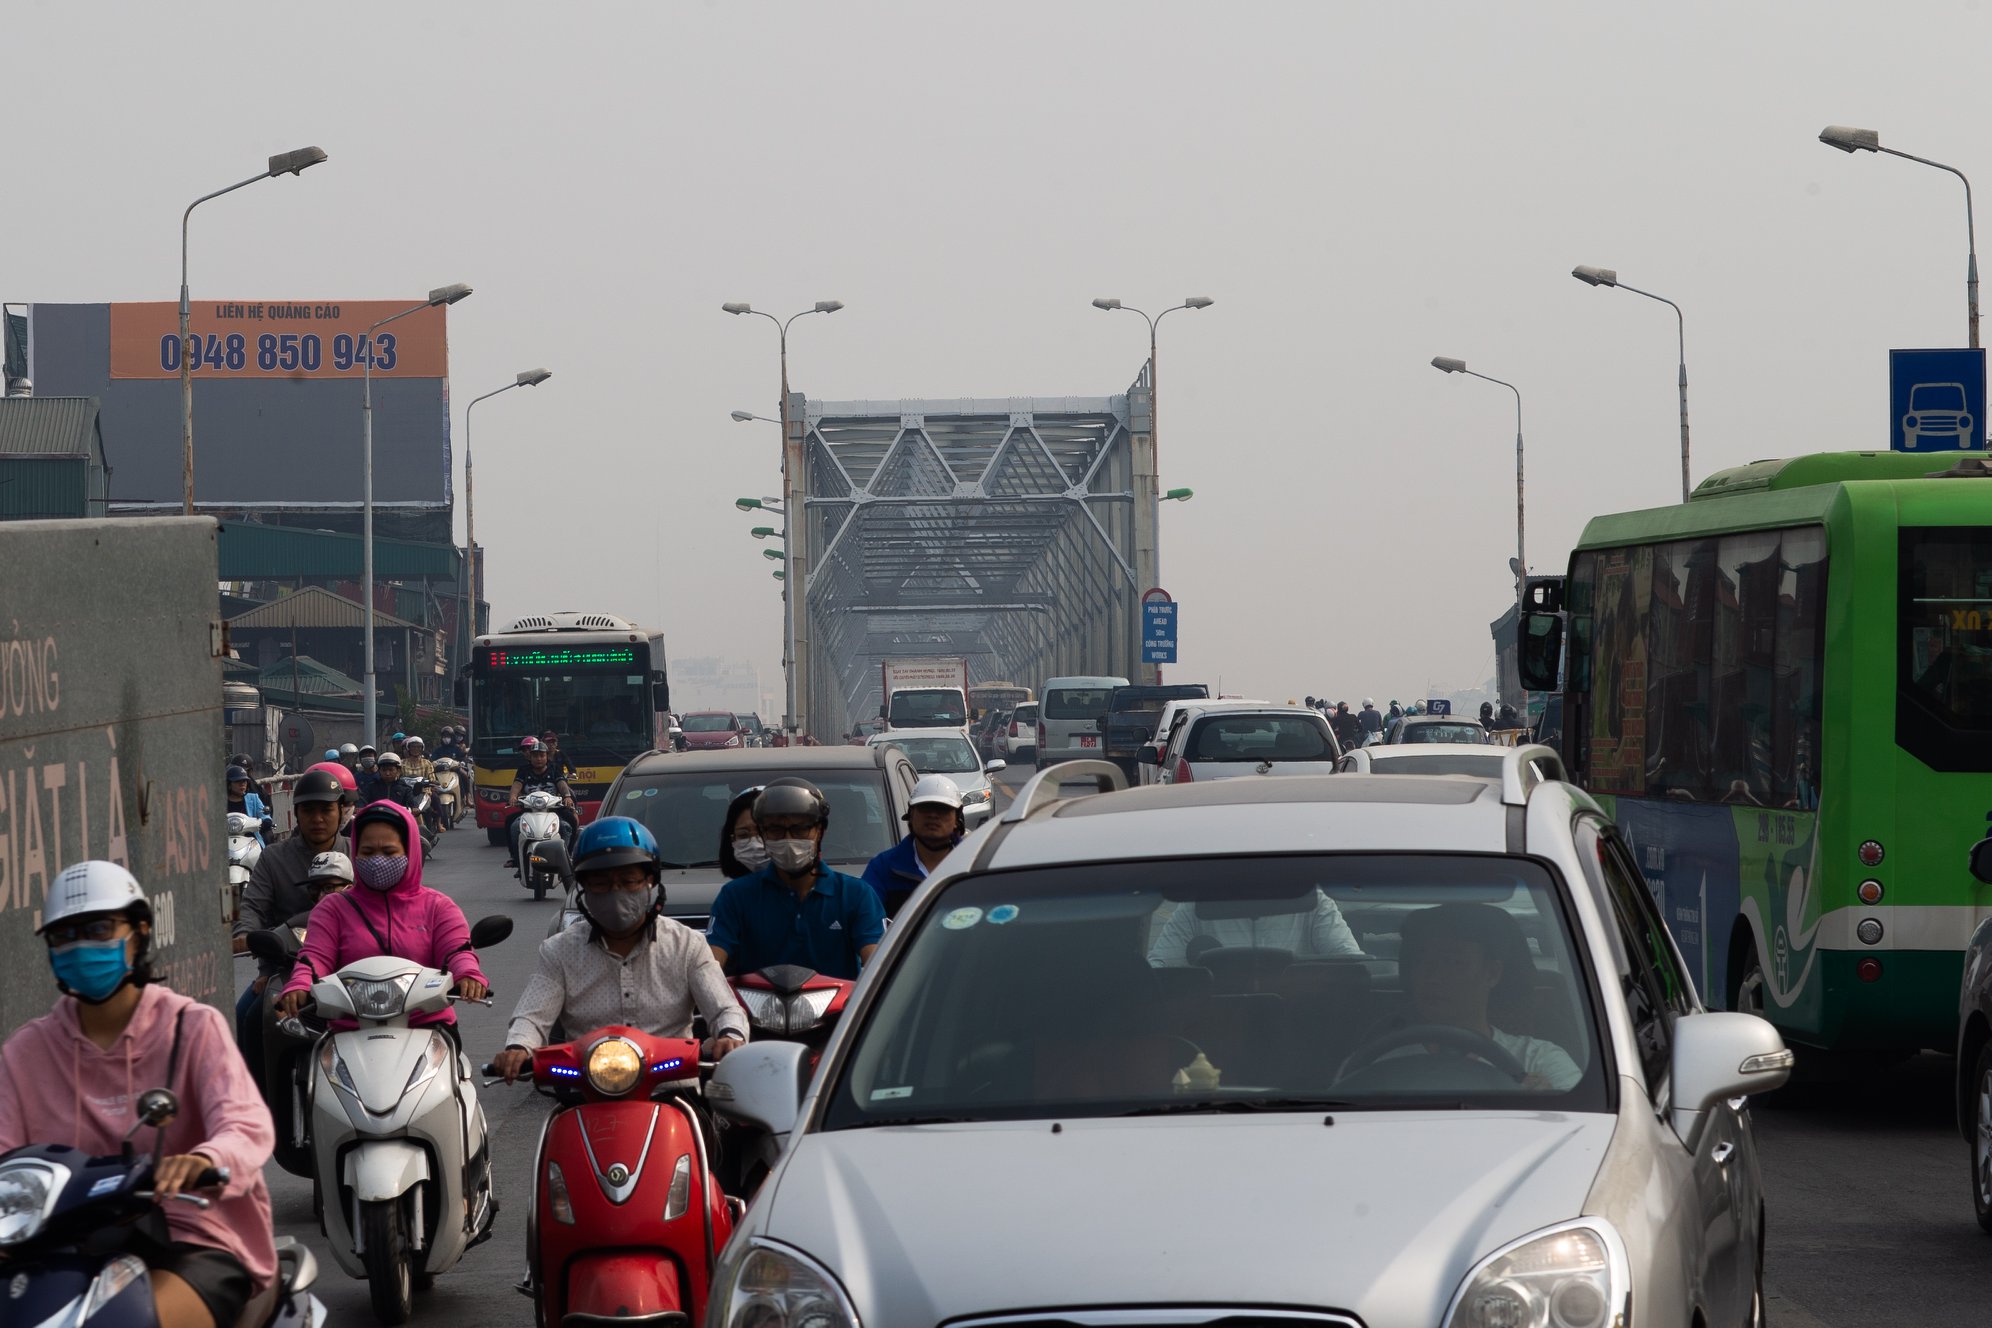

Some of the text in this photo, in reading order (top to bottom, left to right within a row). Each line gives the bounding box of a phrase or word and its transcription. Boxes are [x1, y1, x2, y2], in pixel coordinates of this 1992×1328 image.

[216, 302, 340, 321] LIÊN HỆ QUẢNG CÁO
[160, 332, 398, 372] 0948 850 943
[1153, 617, 1167, 625] AHEAD
[1151, 651, 1167, 659] WORKS
[1432, 701, 1446, 713] G7
